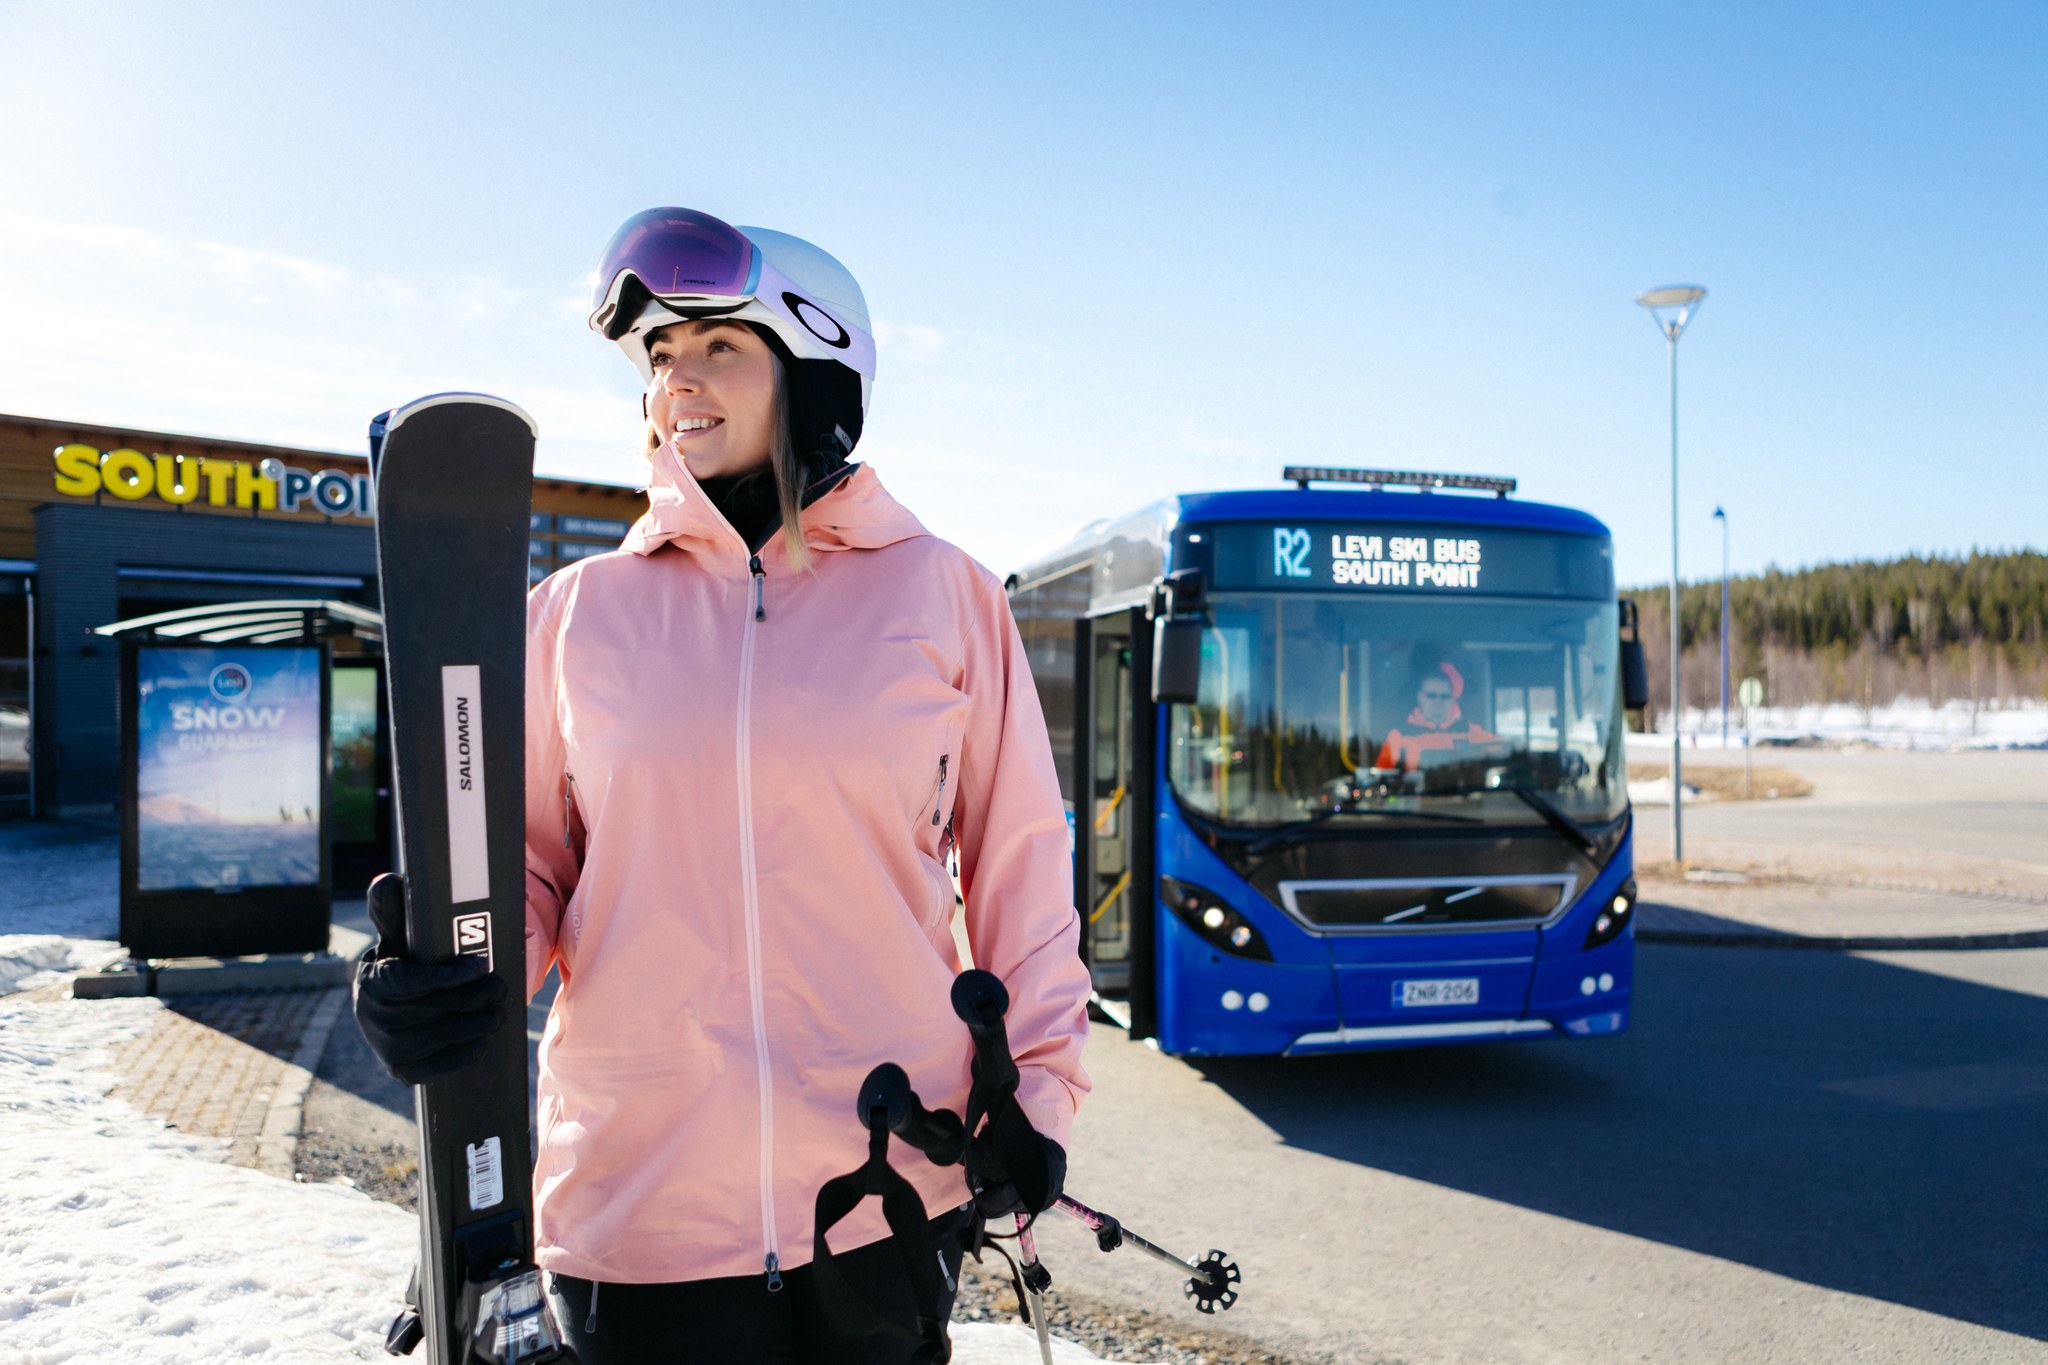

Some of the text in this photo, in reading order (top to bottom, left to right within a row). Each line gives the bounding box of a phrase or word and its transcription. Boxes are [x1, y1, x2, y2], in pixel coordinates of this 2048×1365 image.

[54, 443, 374, 518] SOUTH POI
[1273, 527, 1312, 578] R2
[1332, 535, 1481, 564] LEVI SKI BUS
[1332, 560, 1481, 588] SOUTH POINT
[172, 706, 285, 731] SNOW
[456, 697, 472, 791] SALOMON
